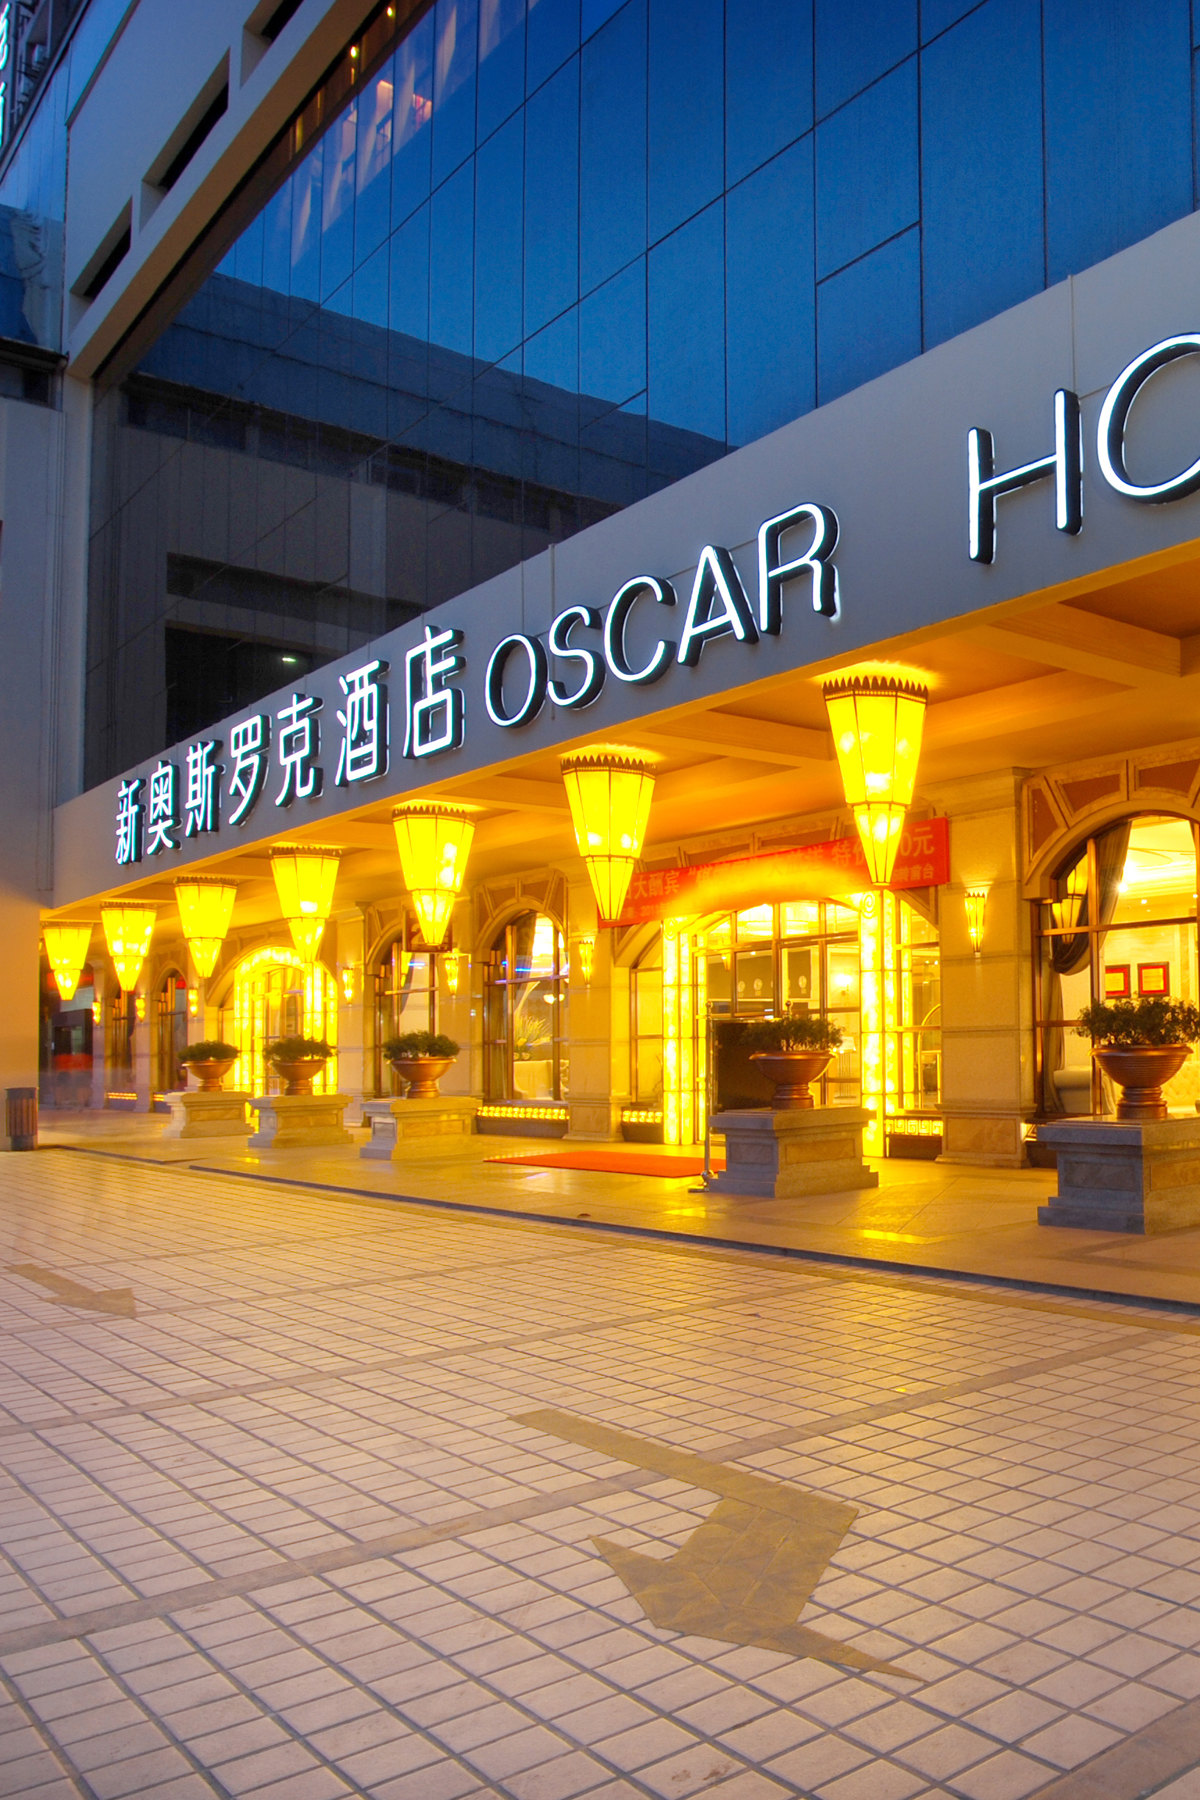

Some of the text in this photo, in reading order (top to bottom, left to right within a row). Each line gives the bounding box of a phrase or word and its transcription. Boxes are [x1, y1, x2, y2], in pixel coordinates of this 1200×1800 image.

[485, 502, 841, 728] OSCAR
[115, 624, 467, 865] 新奥斯罗克酒店
